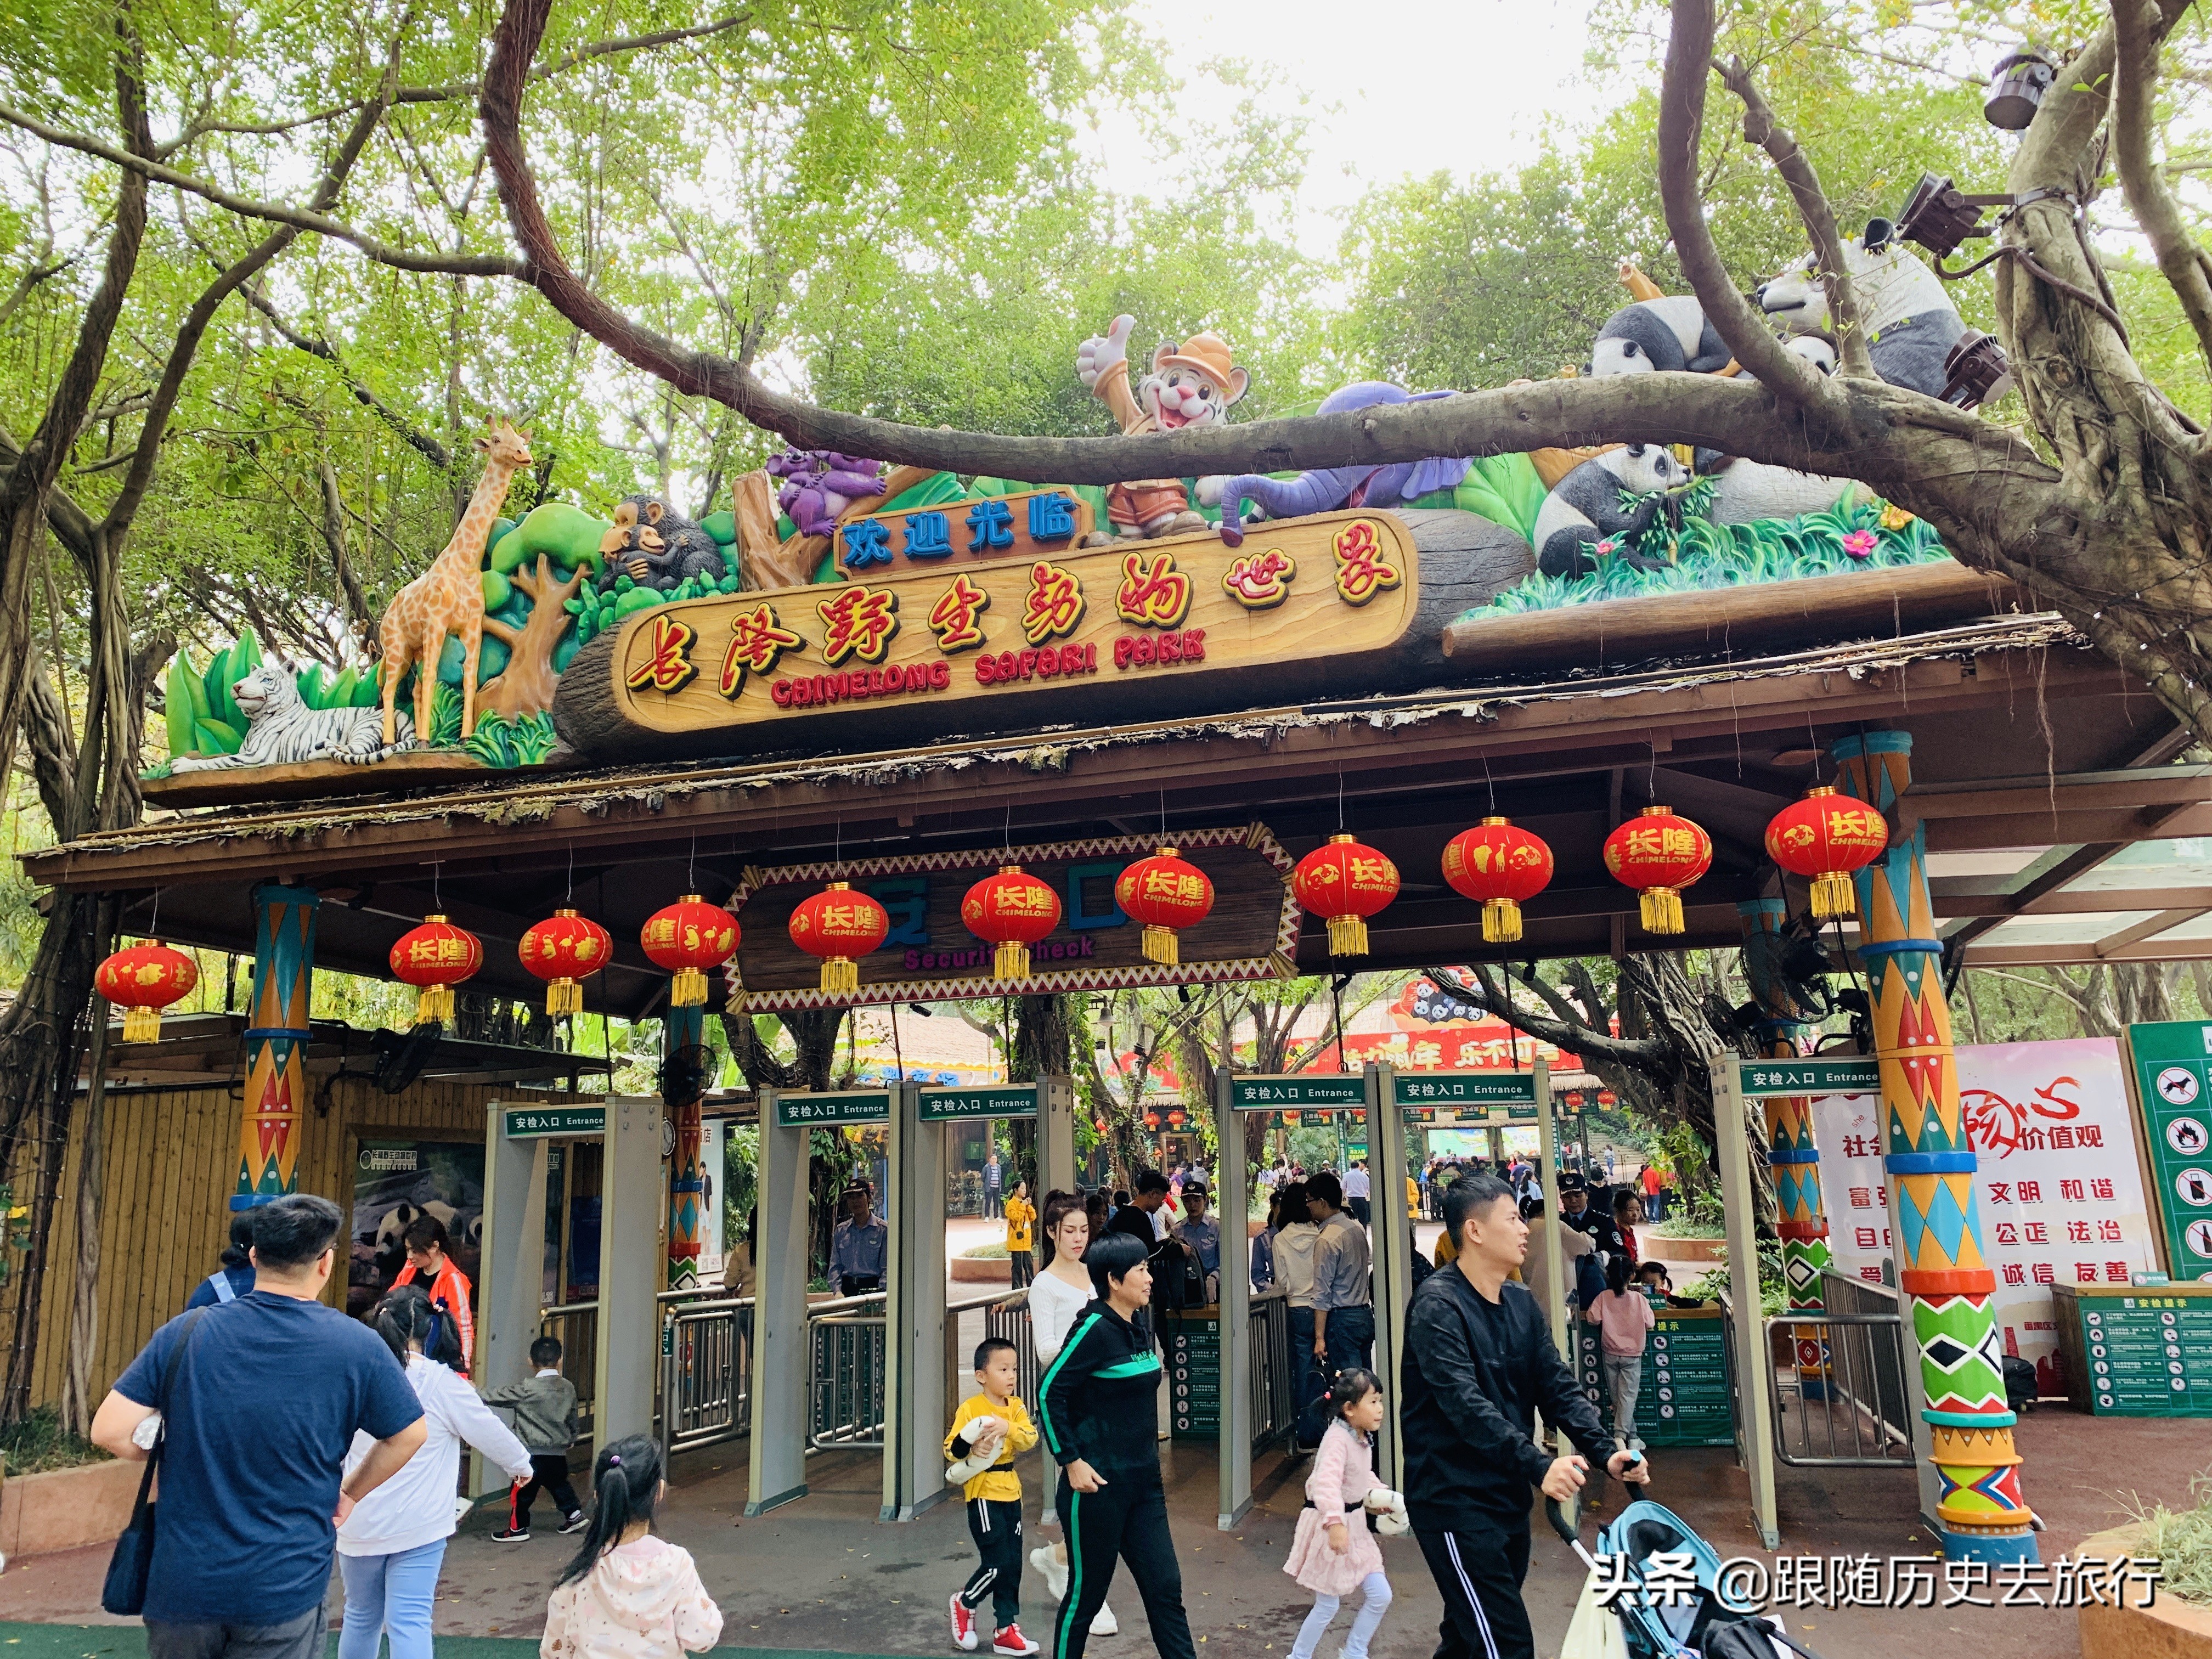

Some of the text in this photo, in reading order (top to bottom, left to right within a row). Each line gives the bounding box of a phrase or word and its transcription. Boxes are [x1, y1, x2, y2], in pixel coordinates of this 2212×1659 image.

[843, 491, 1077, 567] 欢迎光临
[771, 628, 1206, 708] CHIMELONG SAFARI PARK
[1626, 828, 1697, 856] 长隆
[1628, 855, 1695, 864] CHIMELONG
[1145, 870, 1205, 900] 长隆
[994, 885, 1053, 910] 长隆
[1143, 894, 1203, 907] CHIMELONG
[821, 905, 880, 930] 长隆
[995, 909, 1053, 917] CHIMELONG
[642, 918, 676, 942] 隆
[822, 928, 879, 937] CHIMELONG
[408, 938, 468, 962] 长隆
[904, 945, 996, 970] Securit
[1753, 1072, 1878, 1086] 安检入口 Entrance
[1244, 1087, 1354, 1100] 安检入口 Entrance
[1407, 1084, 1522, 1097] 安检入口 Entrance
[788, 1105, 884, 1118] 安检入口 Entrance
[931, 1099, 1030, 1112] 安检入口 Entrance
[516, 1116, 560, 1128] 安检入口
[1852, 1114, 1865, 1128] she
[701, 1127, 712, 1143] 店
[2018, 1125, 2104, 1151] 价值观
[1988, 1180, 2042, 1204] 文明
[2061, 1178, 2115, 1201] 和谐
[1996, 1222, 2049, 1244] 公正
[2068, 1220, 2123, 1242] 法治
[2002, 1263, 2054, 1285] 诚信
[2074, 1262, 2129, 1282] 友善
[1648, 1322, 1679, 1331] 提示
